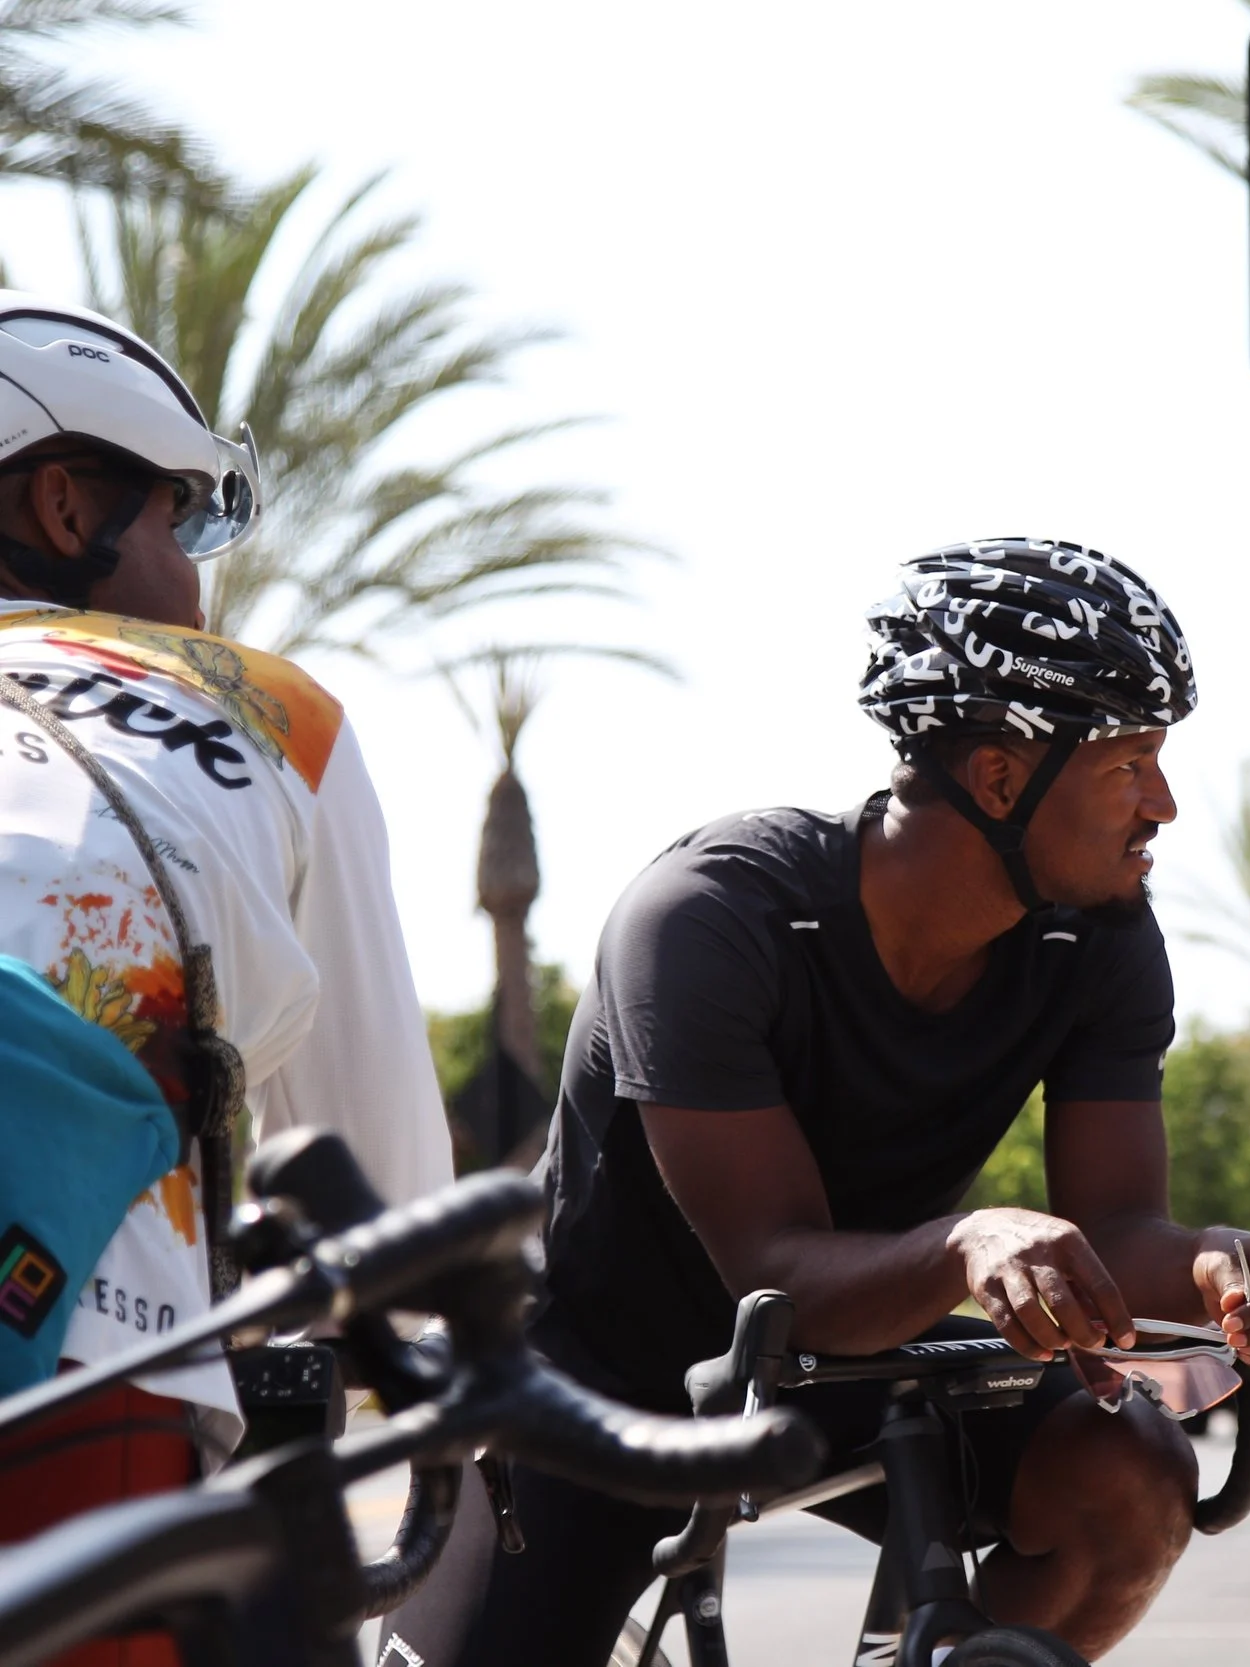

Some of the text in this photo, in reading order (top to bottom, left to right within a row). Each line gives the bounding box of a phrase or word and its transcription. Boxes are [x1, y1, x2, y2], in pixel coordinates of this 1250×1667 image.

[1011, 656, 1075, 686] Supreme
[78, 1278, 175, 1335] ESSO
[987, 1376, 1035, 1389] wahoo
